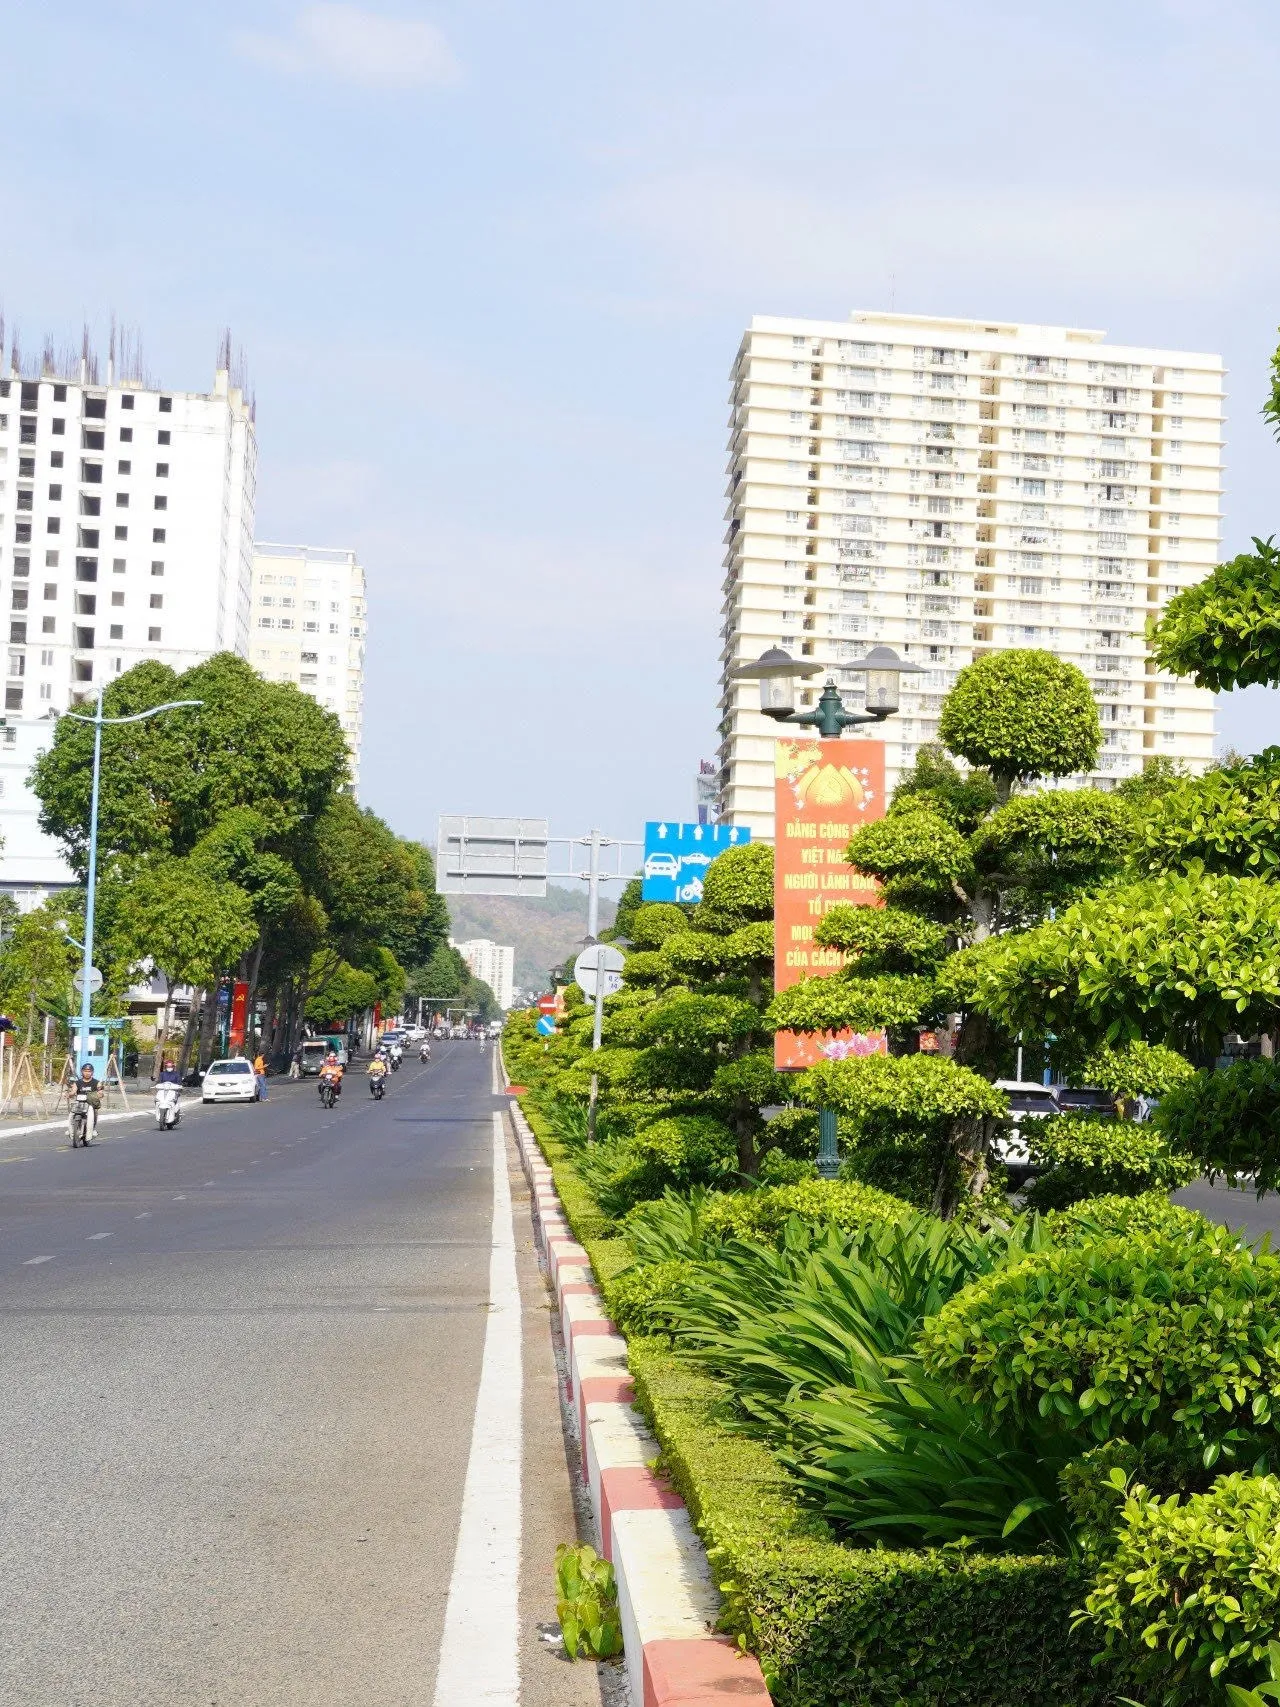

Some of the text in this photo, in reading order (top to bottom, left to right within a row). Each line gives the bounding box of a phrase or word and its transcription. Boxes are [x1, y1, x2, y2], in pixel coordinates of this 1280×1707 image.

[785, 817, 816, 839] ĐẢNG
[819, 821, 849, 841] CỘNG
[801, 846, 824, 867] VIỆT
[784, 871, 818, 889] NGƯỜI
[821, 871, 849, 889] LÃNH
[786, 945, 808, 967] CỦA
